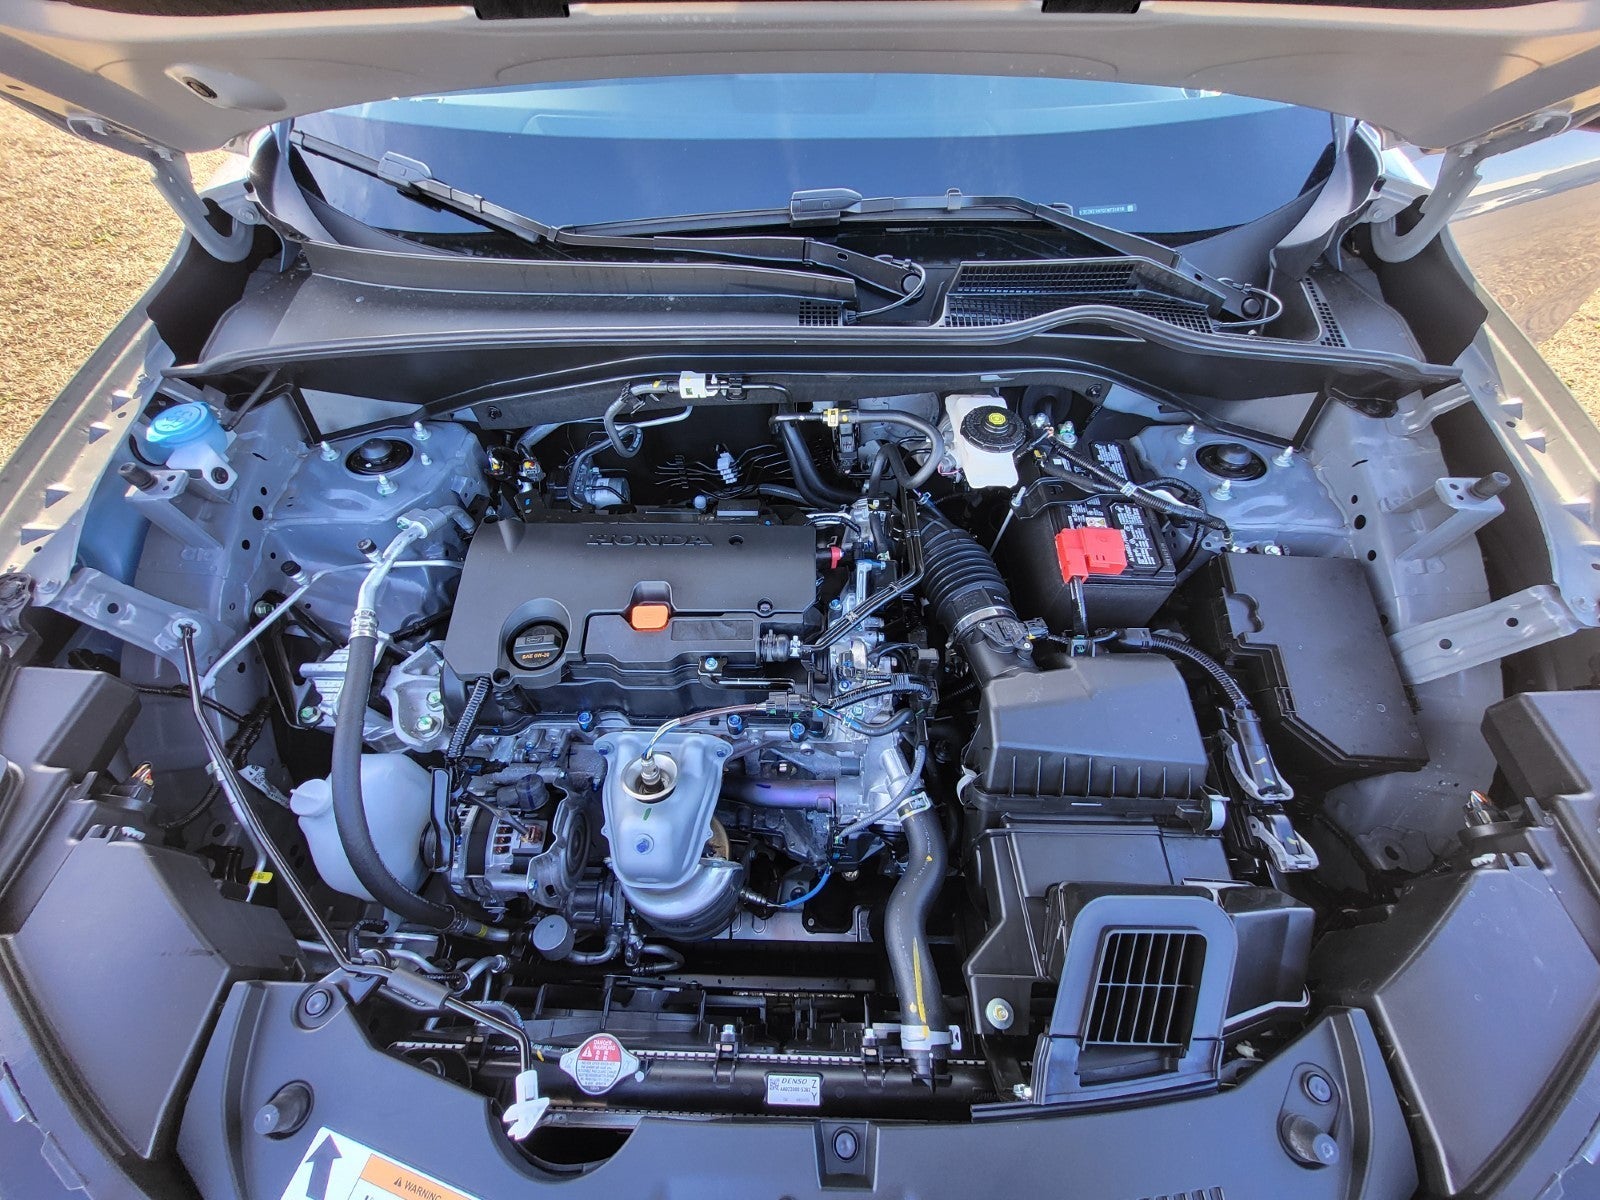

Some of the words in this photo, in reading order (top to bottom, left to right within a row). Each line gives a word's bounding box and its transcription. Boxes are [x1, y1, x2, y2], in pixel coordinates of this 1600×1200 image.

[586, 534, 713, 546] HONDA
[781, 1077, 808, 1085] DENSO
[811, 1079, 817, 1089] Z
[811, 1092, 818, 1102] Y
